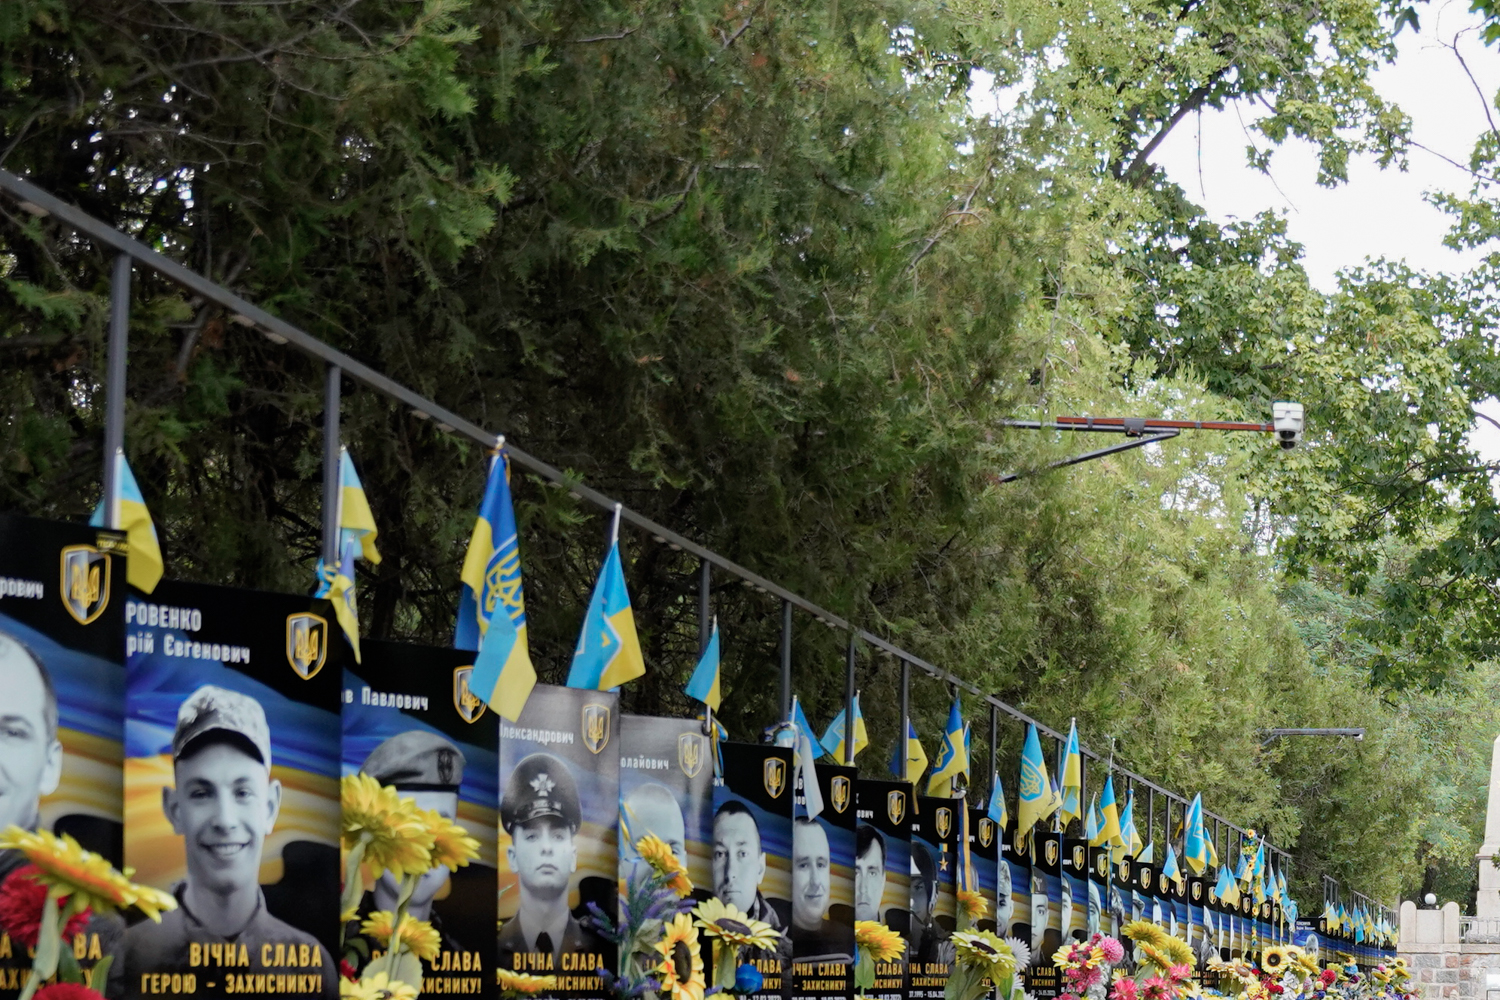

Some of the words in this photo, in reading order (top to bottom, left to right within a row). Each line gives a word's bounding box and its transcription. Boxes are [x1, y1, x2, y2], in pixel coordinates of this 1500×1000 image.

[125, 602, 202, 632] РОВЕНКО
[164, 633, 250, 664] Євгенович
[361, 686, 429, 711] Павлович
[499, 722, 574, 746] лександрович
[190, 943, 249, 967] ВІЧНА
[261, 944, 323, 967] СЛАВА
[430, 951, 482, 972] СЛАВА
[513, 952, 554, 971] ВІЧНА
[561, 952, 604, 971] СЛАВА
[818, 963, 846, 977] СЛАВА
[876, 963, 903, 975] СЛАВА
[925, 963, 949, 975] СЛАВА
[141, 973, 196, 994] ГЕРОЮ
[225, 973, 322, 993] ЗАХИСНИКУ!
[802, 980, 846, 991] ЗАХИСНИКУ!
